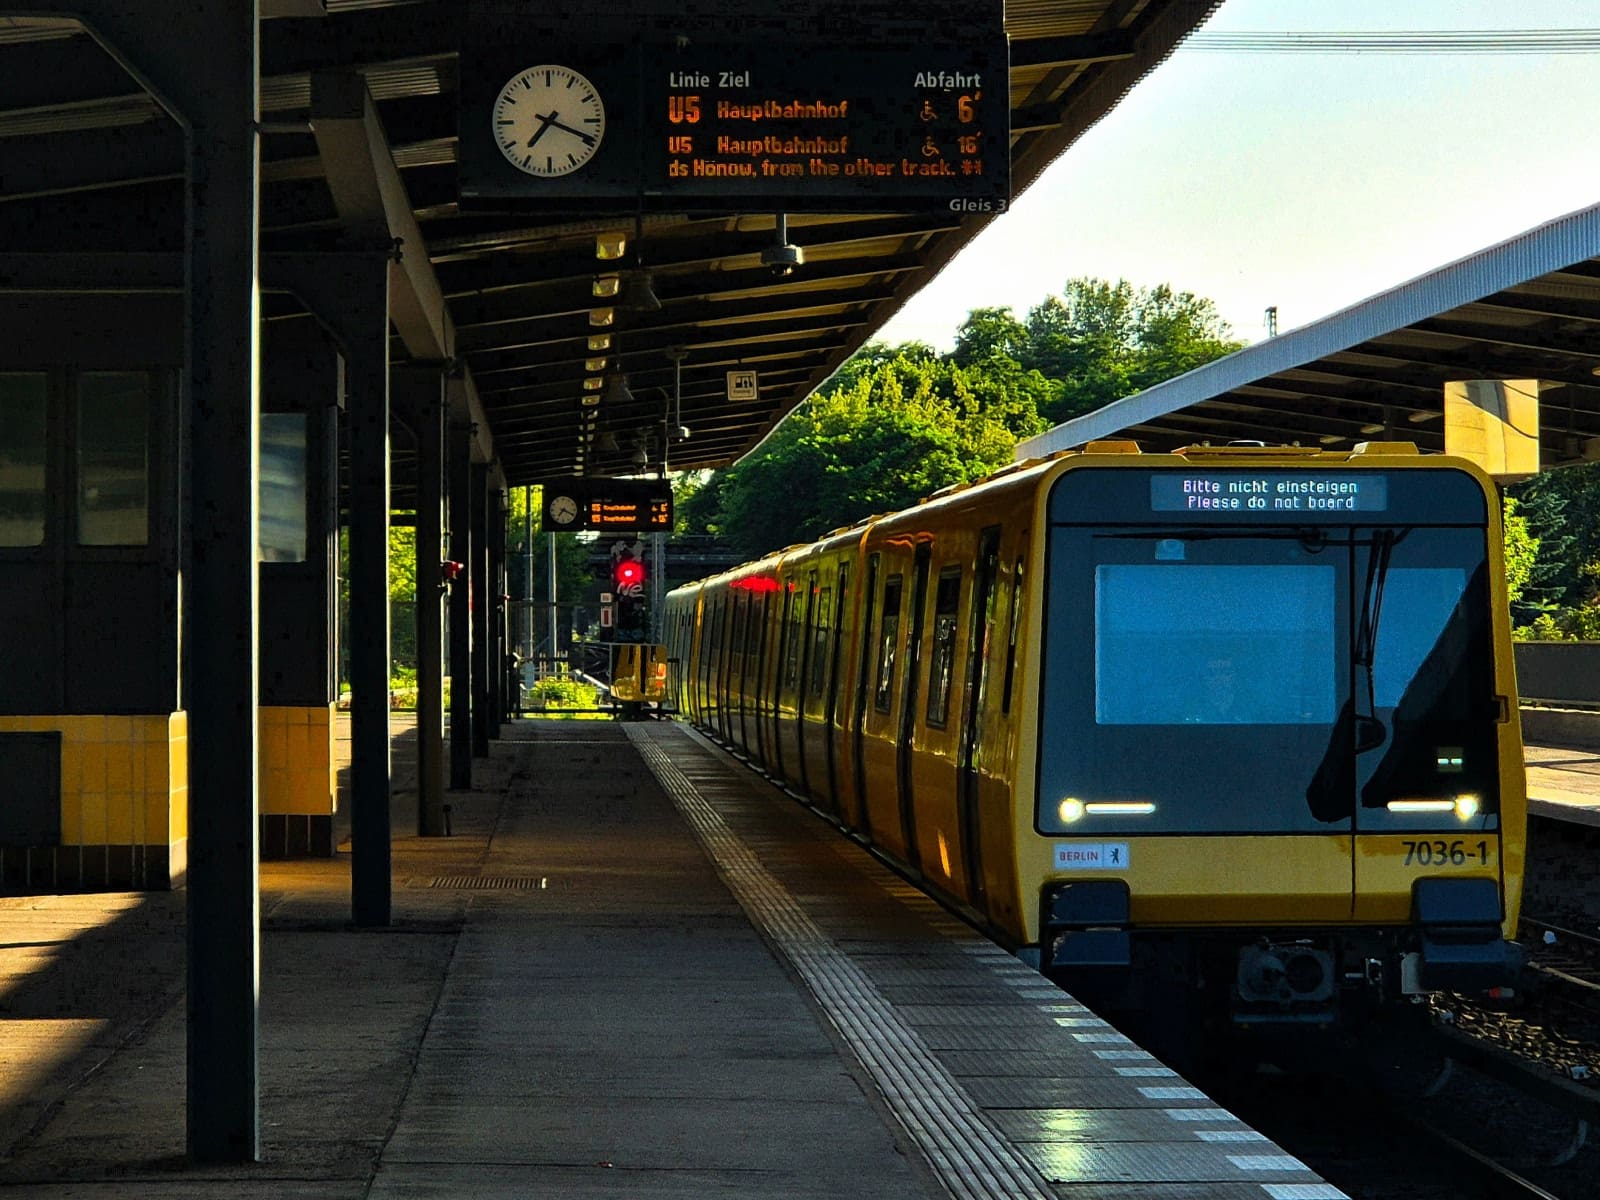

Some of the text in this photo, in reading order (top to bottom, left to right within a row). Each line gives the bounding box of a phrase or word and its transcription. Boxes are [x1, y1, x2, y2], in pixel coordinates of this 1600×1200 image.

[669, 71, 750, 88] Linie Ziel
[913, 71, 982, 88] Abfahrt
[669, 96, 848, 124] U5 Hauptbahnhof
[669, 136, 848, 156] U5 Hauptbahnhof
[762, 159, 803, 176] from
[809, 159, 839, 176] the
[844, 158, 894, 176] other
[902, 158, 956, 176] track.
[949, 198, 1007, 212] Gleis 3
[1183, 480, 1357, 495] Bitte nicht einsteigen
[1188, 495, 1355, 509] Please do not board
[1060, 851, 1098, 861] BERLIN
[1402, 840, 1487, 866] 7036-1
